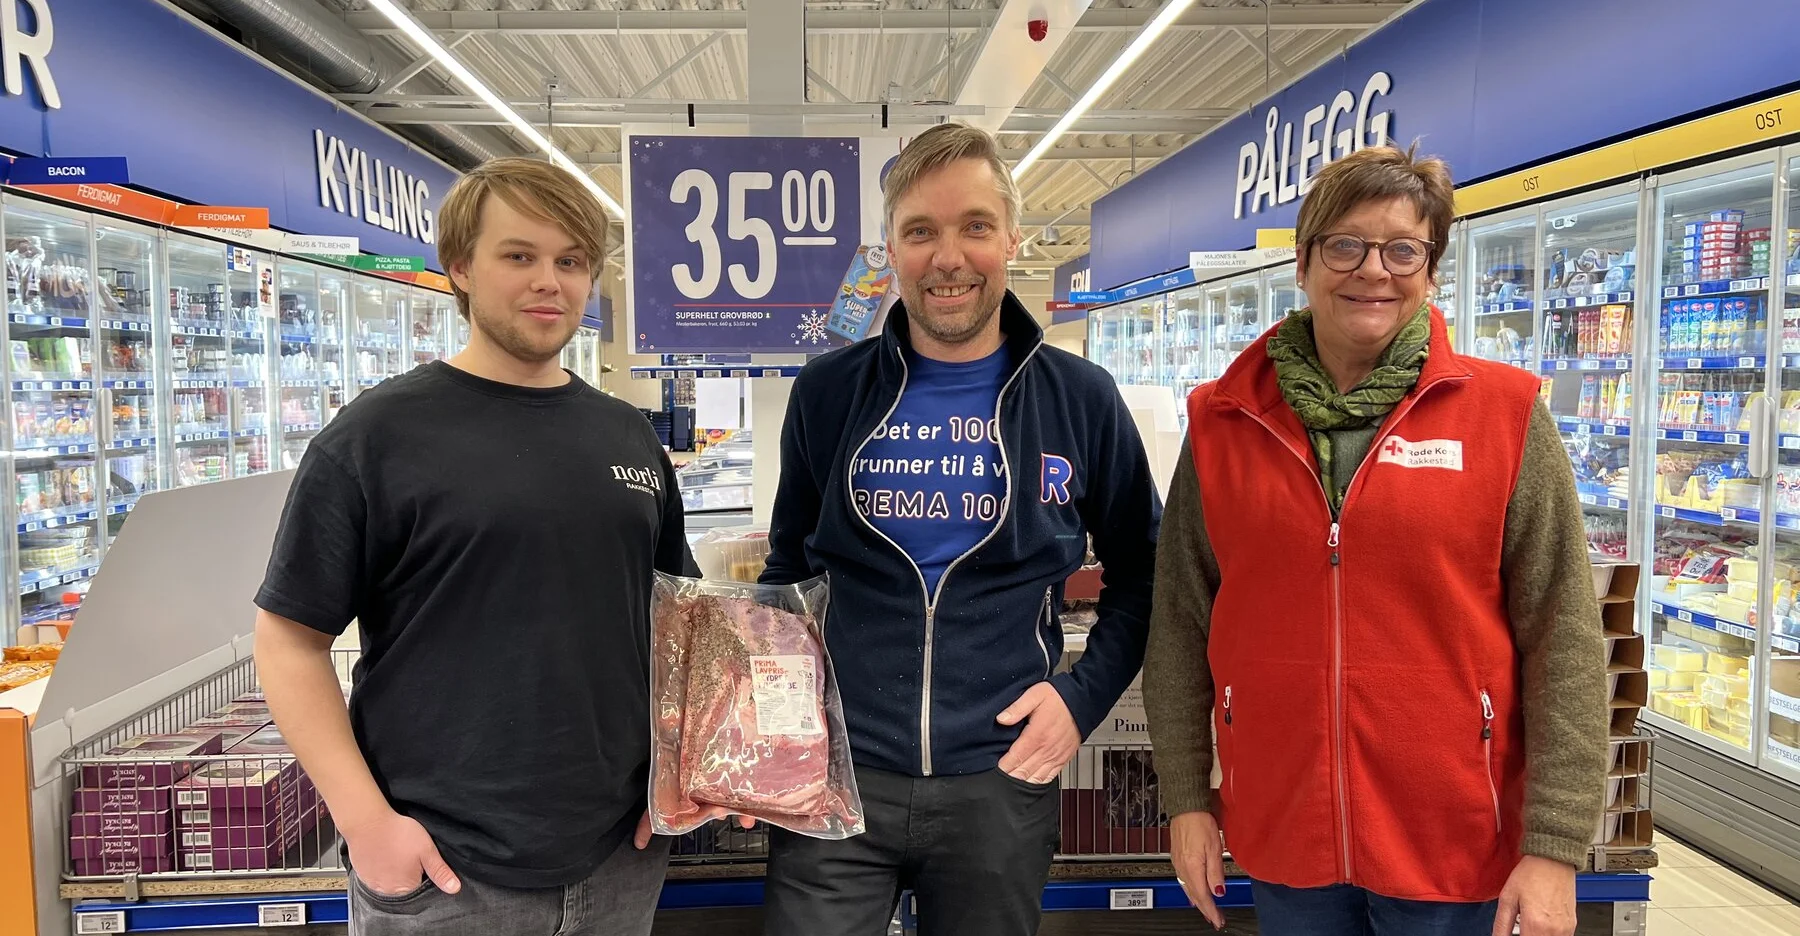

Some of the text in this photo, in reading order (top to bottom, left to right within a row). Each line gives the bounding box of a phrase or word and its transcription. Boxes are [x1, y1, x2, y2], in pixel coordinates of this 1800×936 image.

[1755, 108, 1783, 131] OST
[1233, 71, 1393, 220] PÅLEGG
[47, 166, 86, 177] BACON
[313, 127, 435, 244] KYLLING
[1523, 175, 1540, 193] OST
[77, 184, 122, 207] FERDIGMAT
[197, 212, 246, 222] FERDIGMAT
[669, 168, 836, 300] 35 00
[291, 240, 351, 249] SAUS & TILBEHØR
[1196, 259, 1247, 267] PÅLEGGSSALATER
[675, 311, 763, 320] SUPERHELT GROVBRØD
[873, 421, 911, 440] Det
[917, 424, 942, 440] er
[940, 454, 965, 476] til
[971, 454, 985, 477] å
[609, 465, 661, 491] norli
[1040, 452, 1073, 505] R
[853, 489, 949, 519] REMA
[1127, 899, 1141, 907] 389
[101, 921, 111, 930] 12
[282, 913, 292, 922] 12
